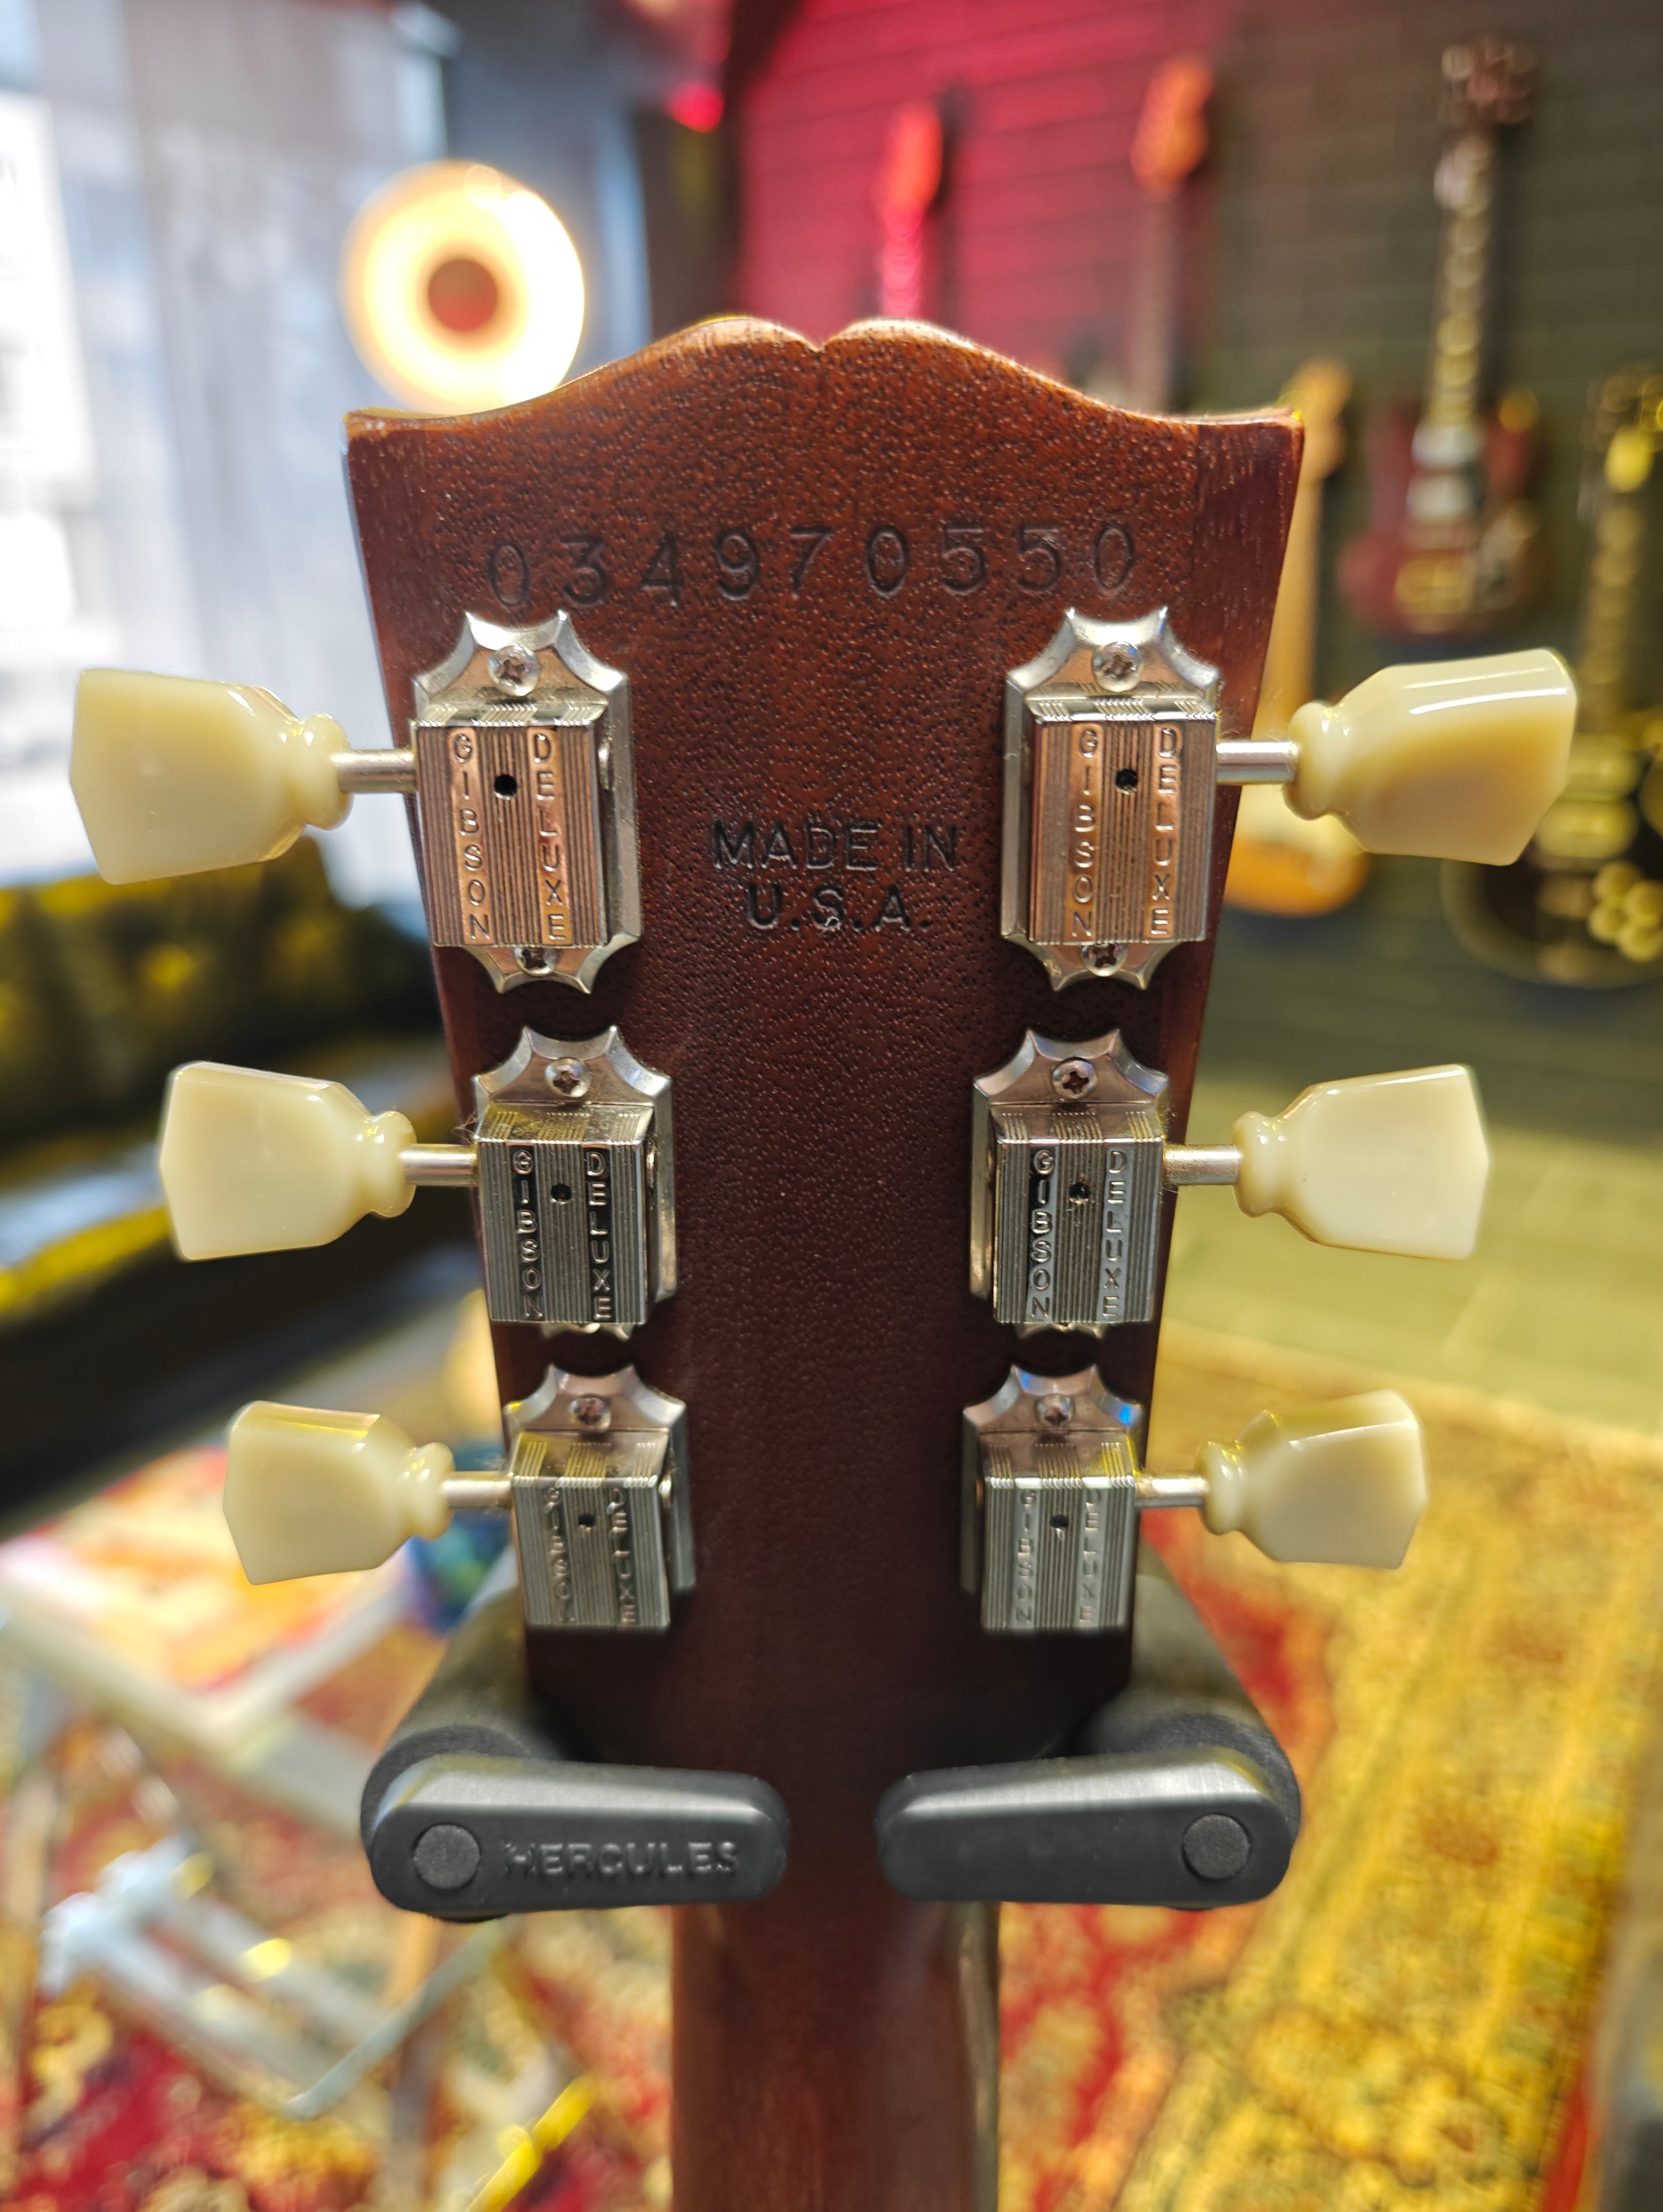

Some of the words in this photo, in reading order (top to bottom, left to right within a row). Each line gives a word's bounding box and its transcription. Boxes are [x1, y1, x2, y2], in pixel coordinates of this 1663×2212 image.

[487, 523, 1136, 607] 034970550
[452, 732, 491, 941] GIBSON
[532, 733, 566, 941] DELUXE
[712, 817, 881, 870] MADE
[903, 824, 957, 873] IN
[746, 883, 931, 933] U.S.A.
[1070, 728, 1098, 938] GIBSON
[1150, 727, 1178, 936] DELUXE
[513, 1149, 543, 1319] GIBSON
[585, 1150, 612, 1321] DELUXE
[1031, 1149, 1056, 1319] GIBSON
[1101, 1150, 1128, 1318] DELUXE
[503, 1840, 740, 1876] HERCULES
